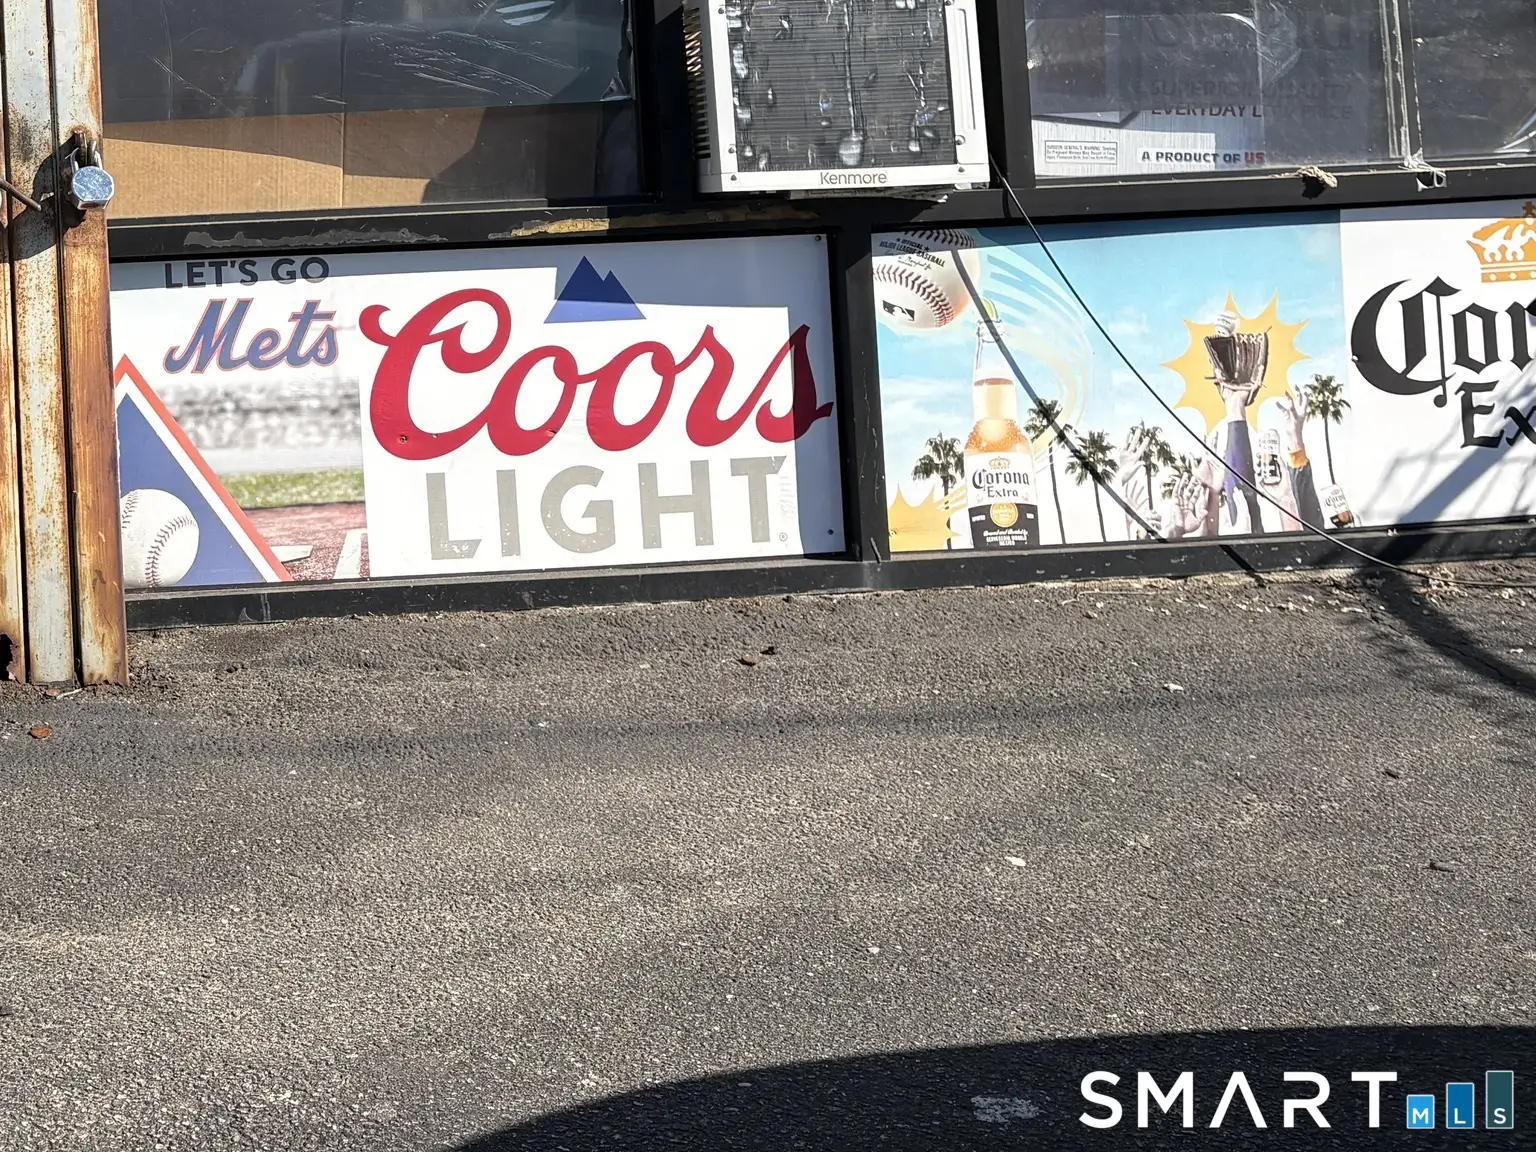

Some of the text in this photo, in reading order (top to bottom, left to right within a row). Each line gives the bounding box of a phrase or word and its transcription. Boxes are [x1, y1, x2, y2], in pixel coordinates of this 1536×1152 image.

[1152, 104, 1245, 118] EVERYDAY
[1141, 151, 1151, 162] A
[1155, 151, 1220, 164] PRODUCT
[1223, 153, 1240, 164] OF
[819, 169, 887, 185] Kenmore
[163, 255, 331, 289] LET'S GO
[161, 298, 340, 375] Mets
[358, 287, 835, 461] Coors
[972, 469, 1030, 491] Corona
[987, 486, 1019, 498] Extra
[425, 455, 787, 563] LIGHT
